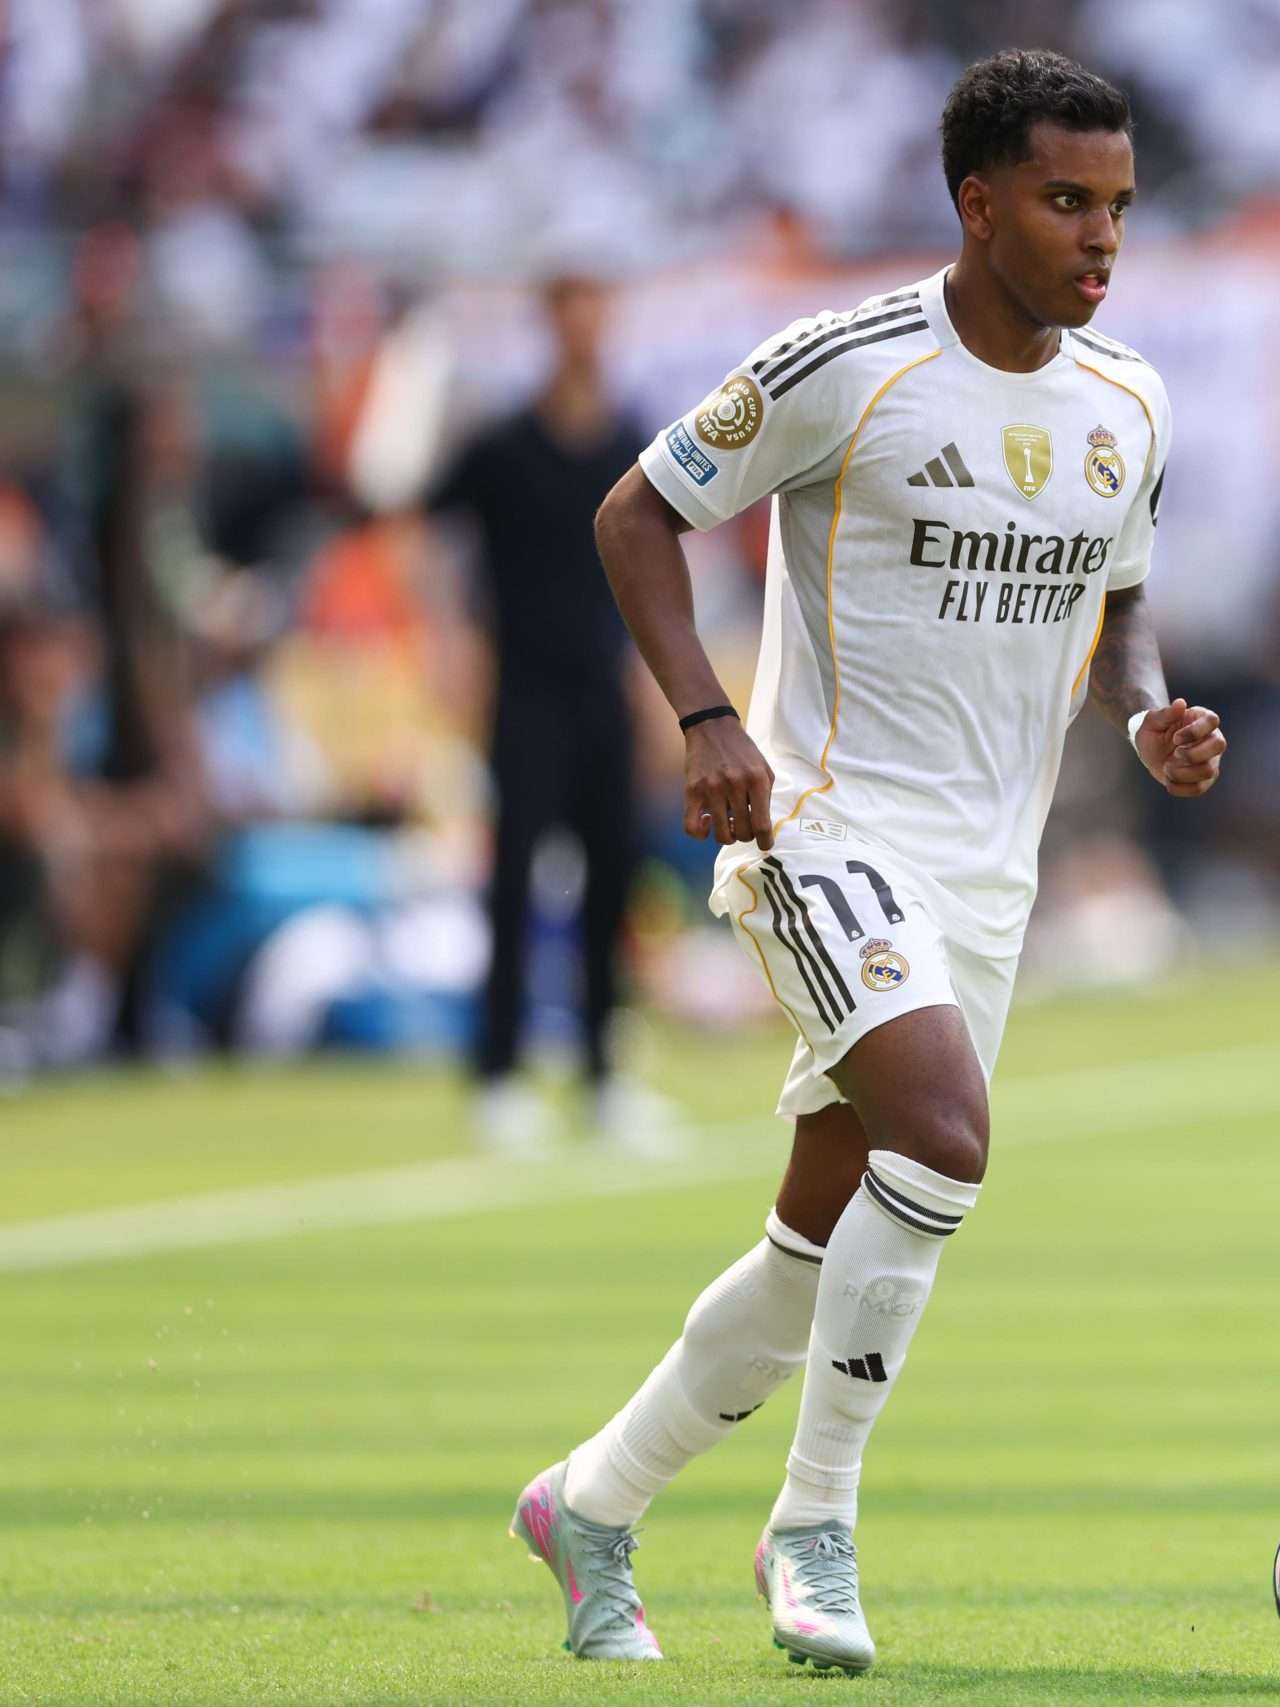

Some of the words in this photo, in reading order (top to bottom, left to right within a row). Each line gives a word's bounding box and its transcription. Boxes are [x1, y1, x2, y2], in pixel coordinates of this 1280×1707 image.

[747, 397, 757, 417] CUP
[698, 415, 719, 441] FIFA
[726, 430, 746, 442] USA
[691, 450, 712, 472] UNITES
[910, 518, 1113, 574] Emirates
[938, 580, 989, 622] FLY
[995, 582, 1086, 624] BETTER
[798, 860, 906, 942] 11
